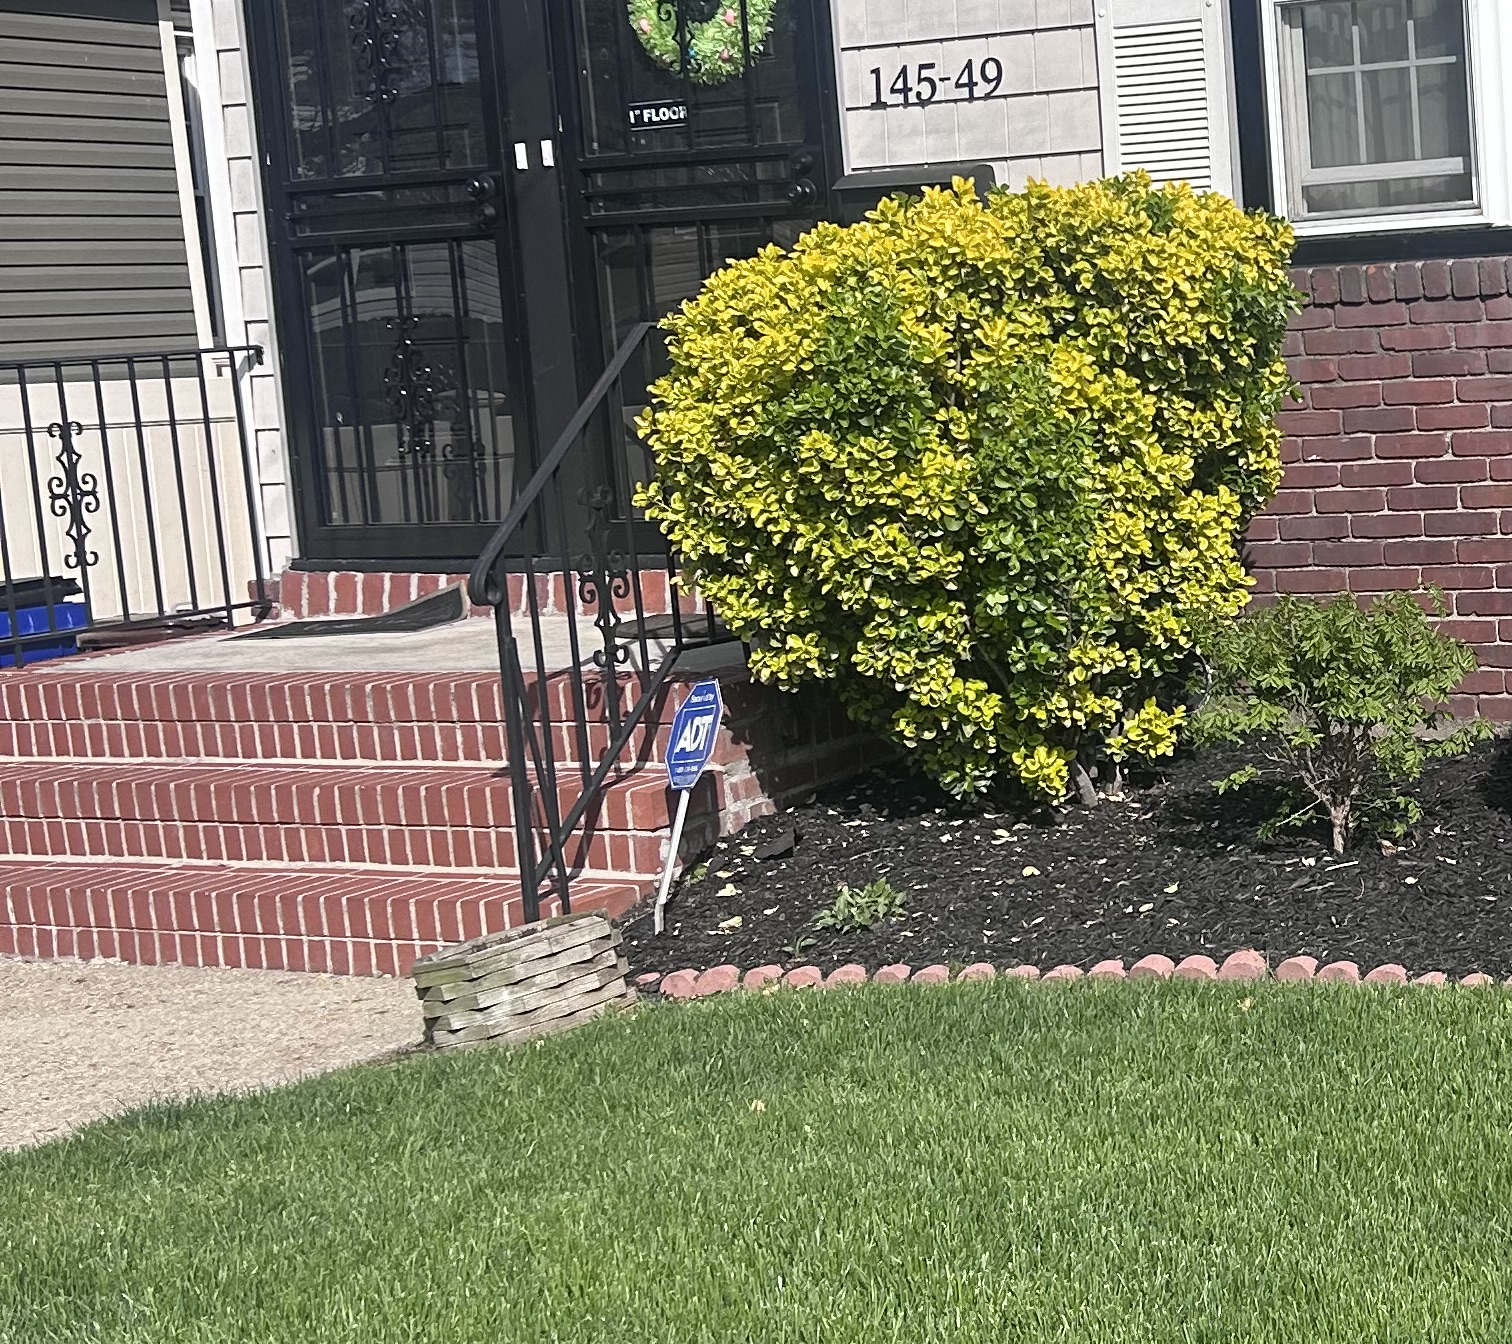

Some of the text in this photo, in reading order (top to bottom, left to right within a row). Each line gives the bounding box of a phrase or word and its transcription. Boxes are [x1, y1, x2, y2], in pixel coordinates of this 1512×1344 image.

[870, 57, 1003, 109] 145-49
[643, 106, 688, 123] FLOOR
[674, 715, 714, 753] ADT
